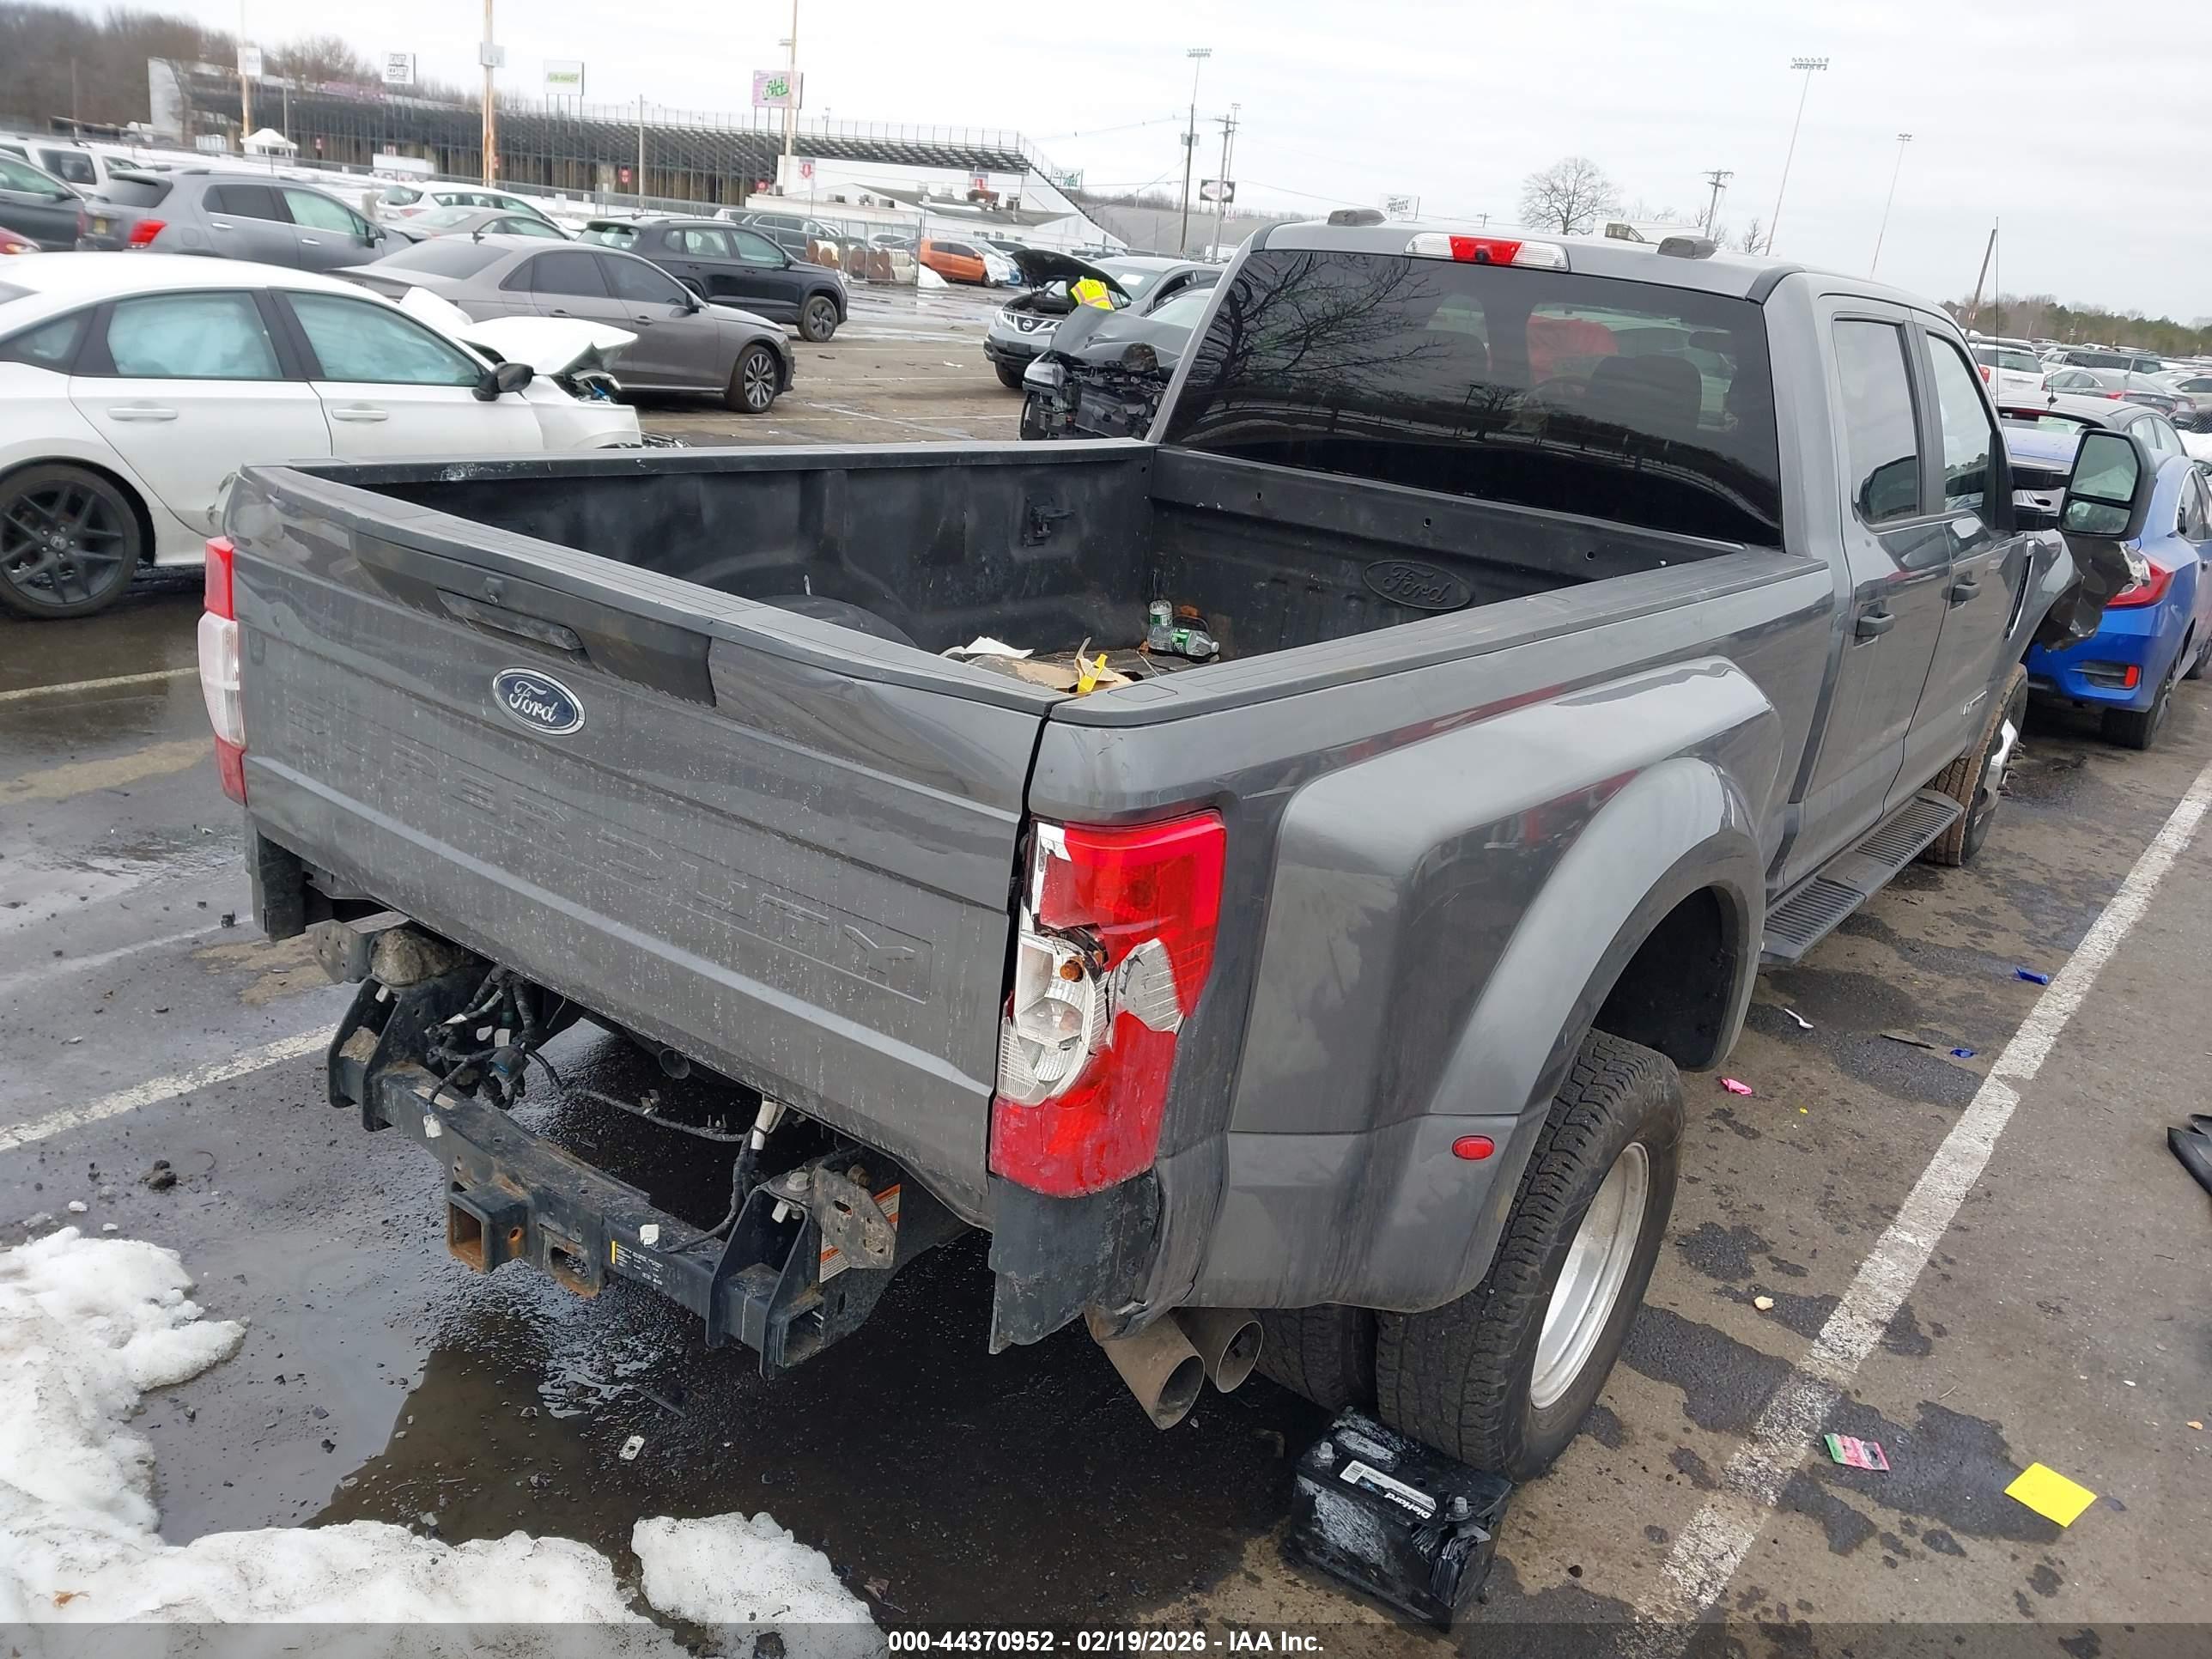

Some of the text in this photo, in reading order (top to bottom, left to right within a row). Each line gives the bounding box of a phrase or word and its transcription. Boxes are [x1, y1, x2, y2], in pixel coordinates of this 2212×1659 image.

[1382, 563, 1451, 604] Ford
[508, 679, 560, 723] Ford
[1383, 1491, 1433, 1520] DieHard
